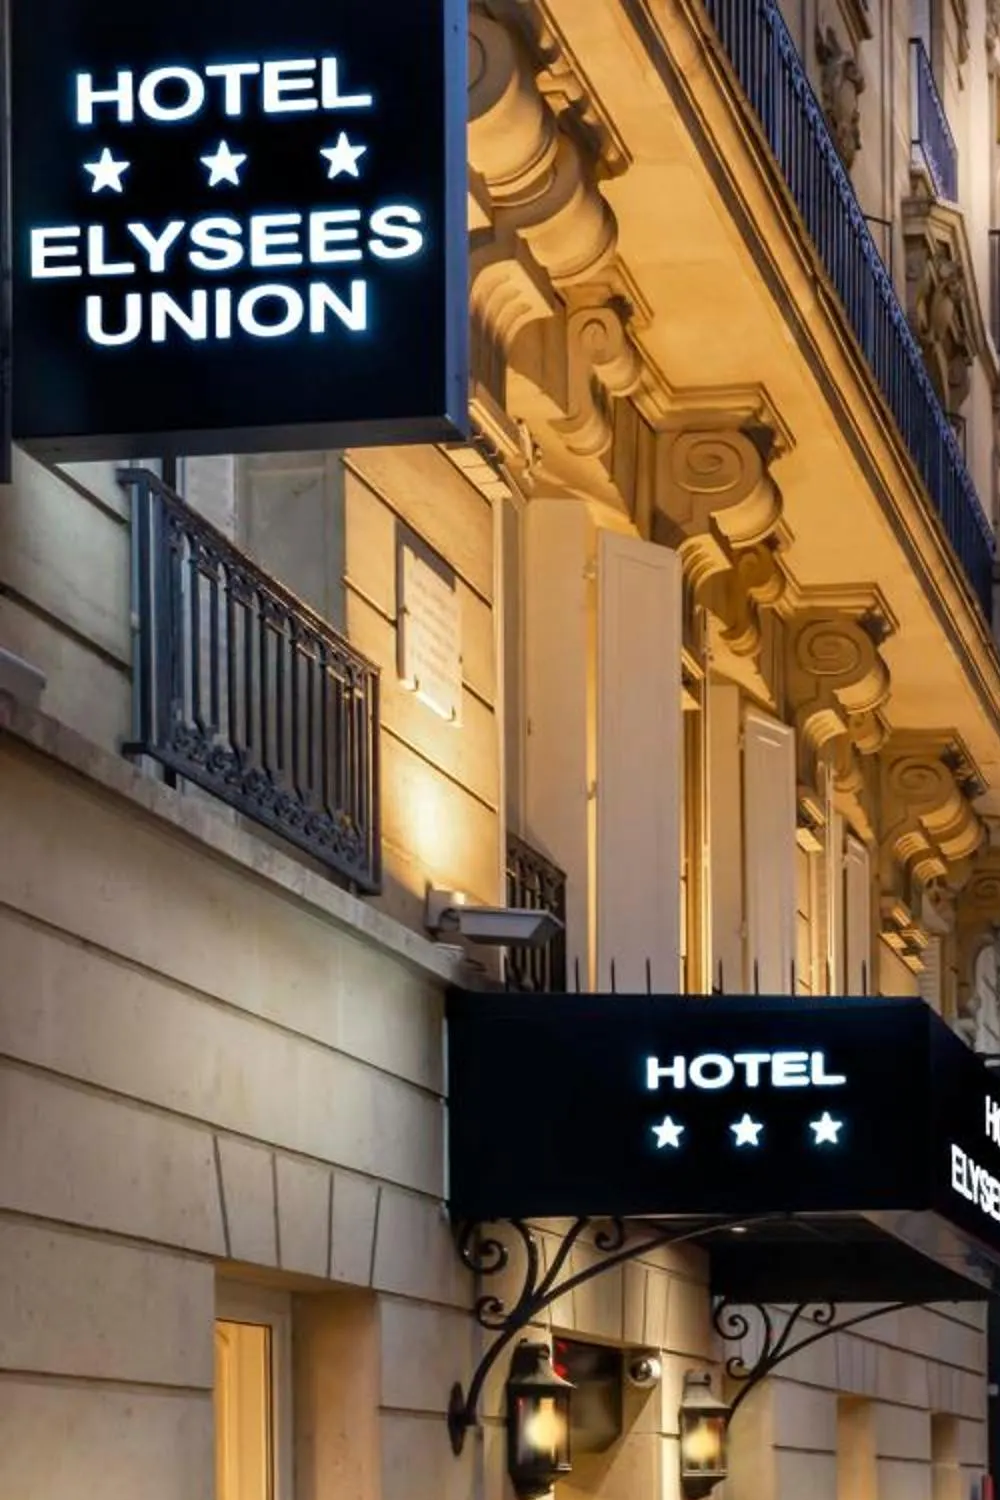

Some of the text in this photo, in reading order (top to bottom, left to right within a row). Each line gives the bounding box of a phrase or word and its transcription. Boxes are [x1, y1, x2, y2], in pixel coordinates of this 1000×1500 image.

[76, 57, 372, 125] HOTEL
[30, 205, 423, 279] ELYSEES
[86, 279, 367, 345] UNION
[645, 1051, 846, 1090] HOTEL
